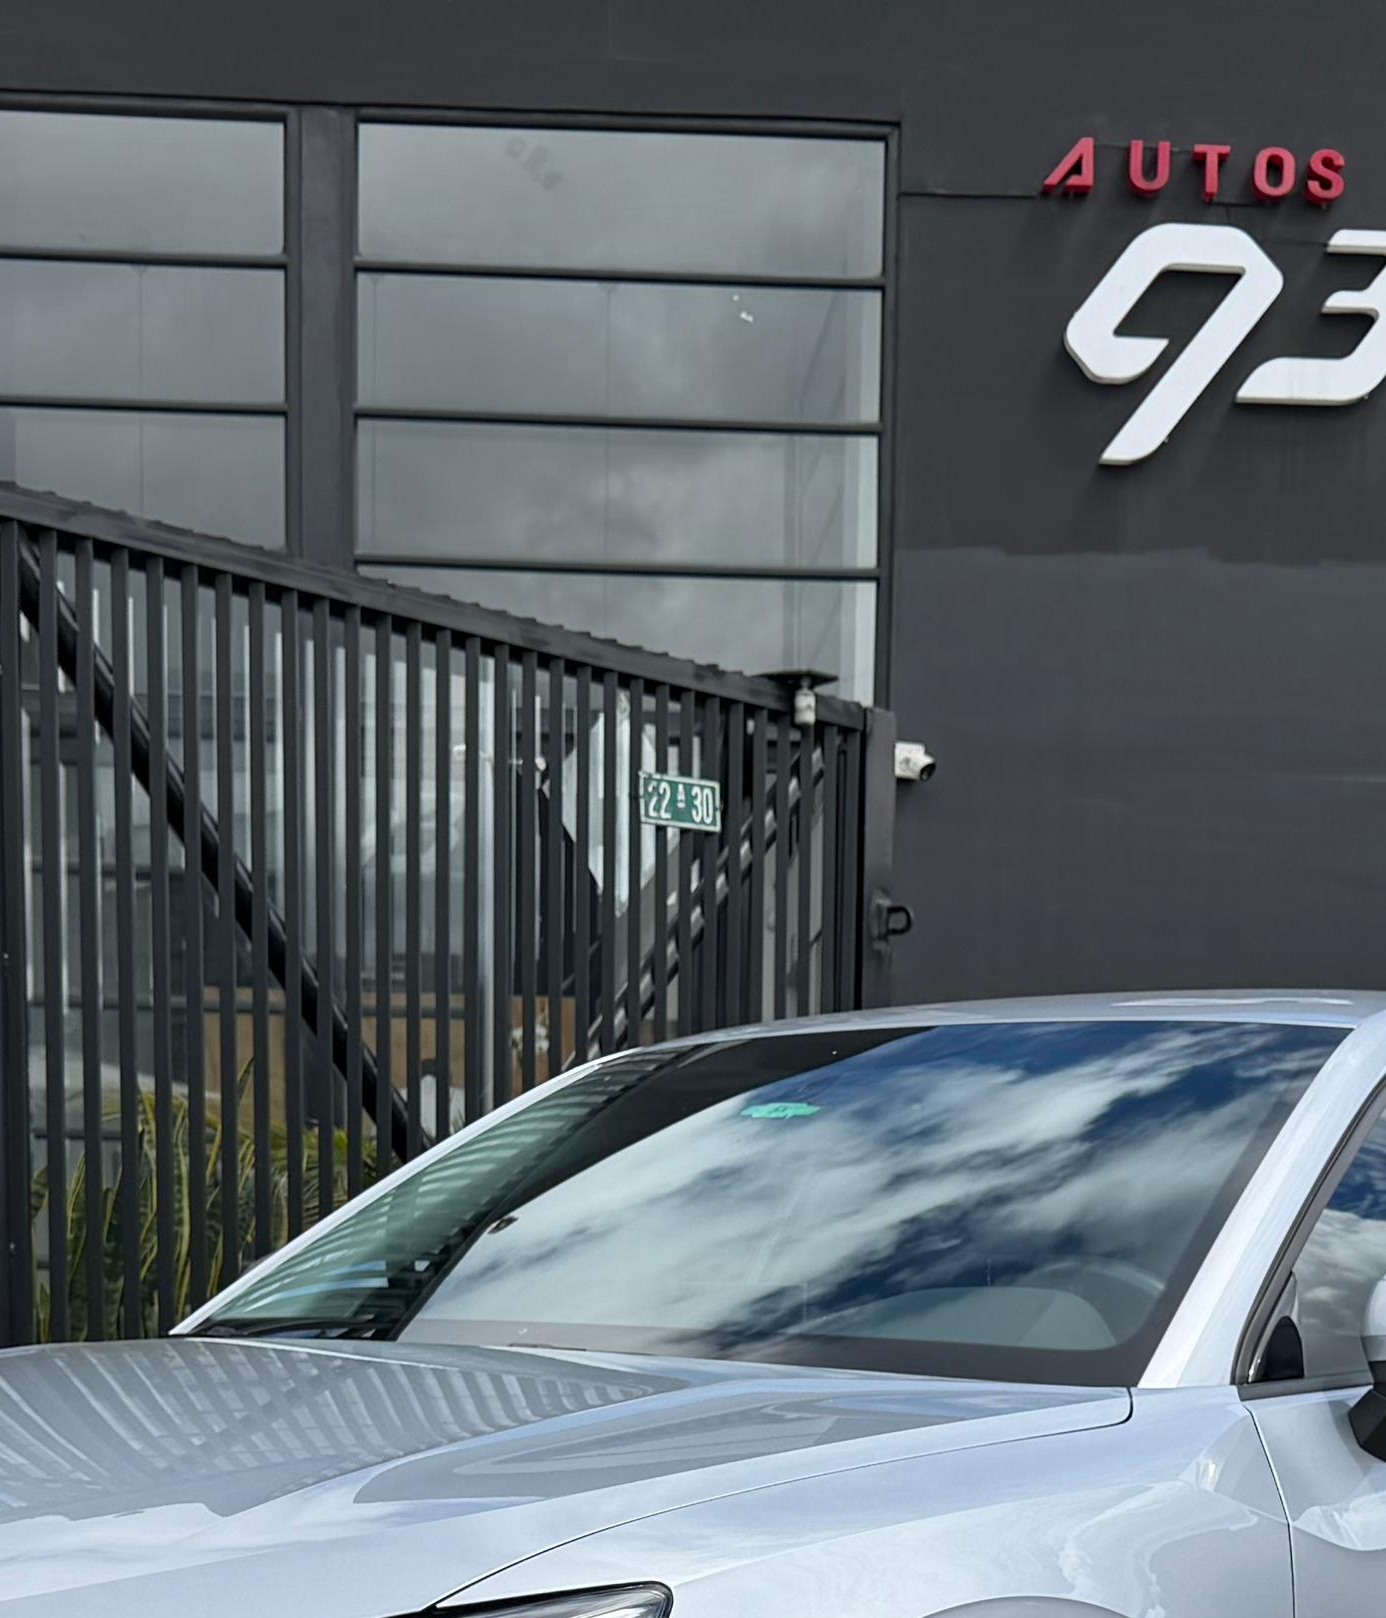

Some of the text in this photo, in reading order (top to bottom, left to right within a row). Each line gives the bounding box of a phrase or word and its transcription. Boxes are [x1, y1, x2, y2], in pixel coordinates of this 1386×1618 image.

[1042, 137, 1346, 207] AUTOS
[647, 780, 672, 819] 22
[691, 785, 714, 824] 30
